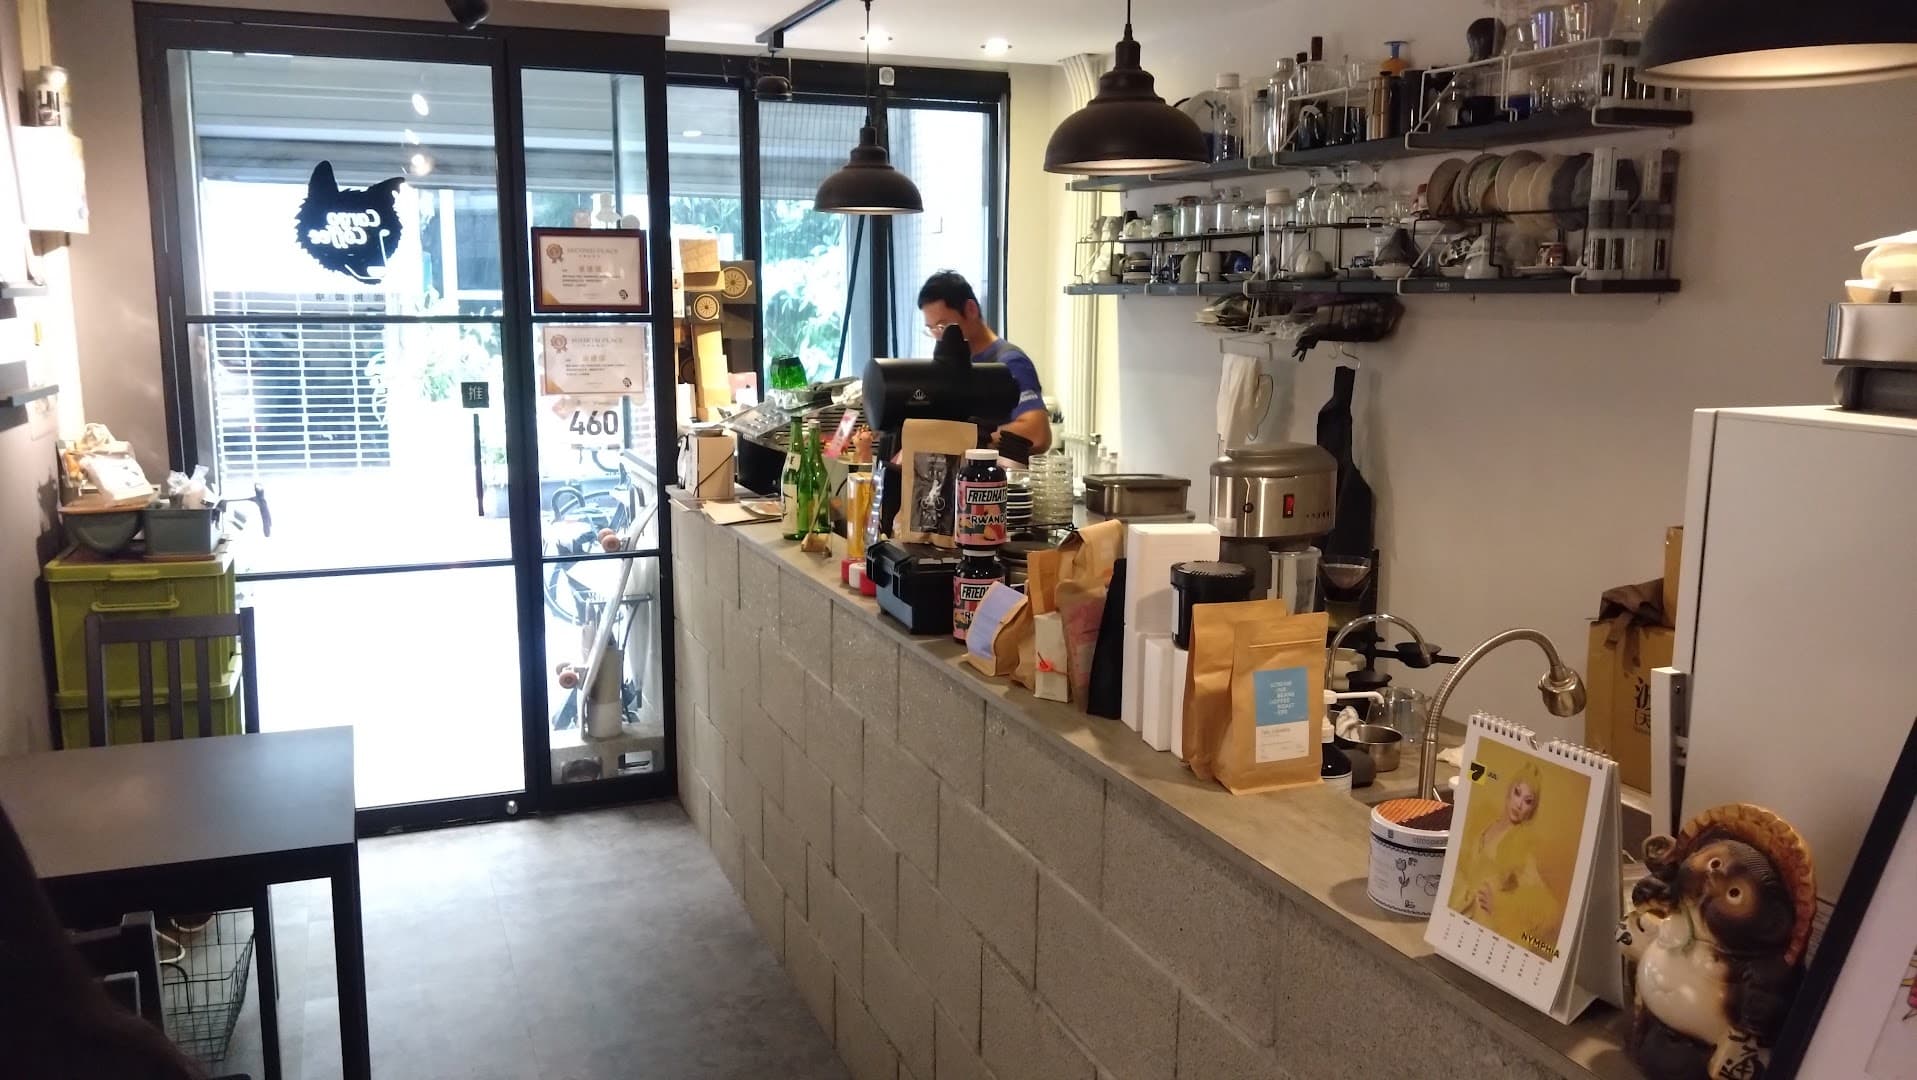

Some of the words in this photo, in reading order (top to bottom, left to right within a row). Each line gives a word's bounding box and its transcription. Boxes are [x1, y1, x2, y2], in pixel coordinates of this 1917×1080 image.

[469, 385, 483, 401] 推
[569, 410, 619, 435] 460
[1470, 762, 1486, 781] 7
[1521, 931, 1560, 958] NYMPHIA
